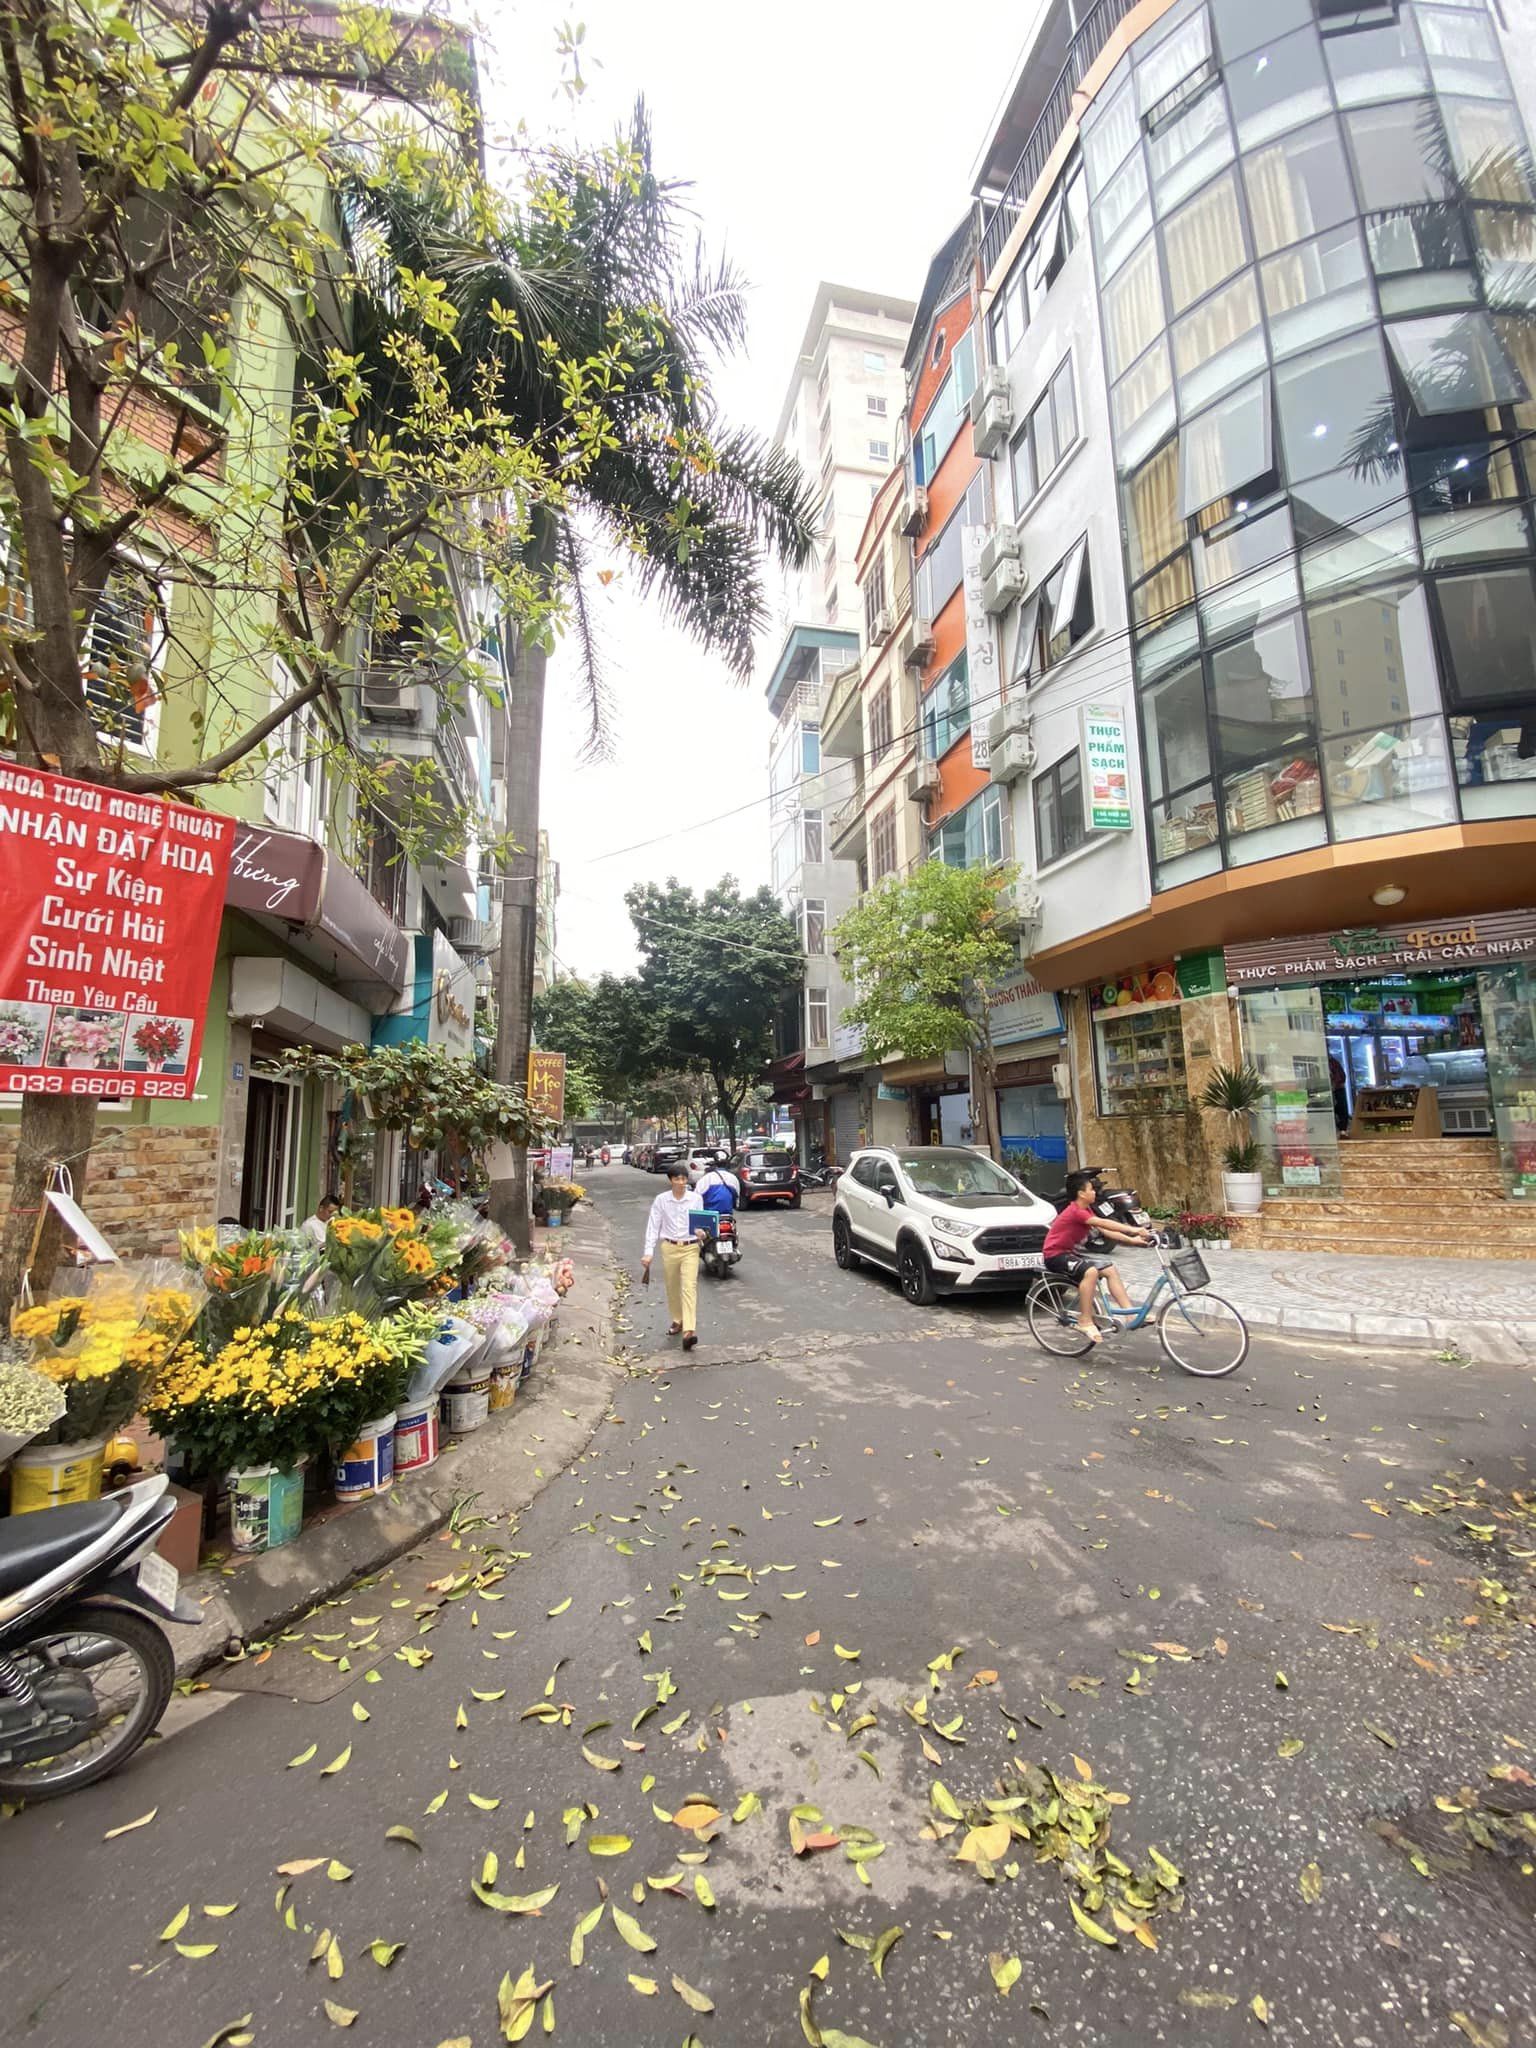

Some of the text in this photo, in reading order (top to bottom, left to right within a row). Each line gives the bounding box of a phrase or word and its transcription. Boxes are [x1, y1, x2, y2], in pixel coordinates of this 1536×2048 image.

[1089, 725, 1121, 738] THỰC
[1091, 758, 1125, 770] SẠCH
[0, 770, 225, 842] HOA TƯƠI NGHỆ THUẬT
[0, 804, 214, 876] NHẬN ĐẶT HOA
[55, 857, 163, 907] Sự Kiện
[41, 895, 166, 945] Cưới Hỏi
[1406, 926, 1478, 949] Food
[27, 935, 166, 986] Sinh Nhật
[1237, 965, 1278, 980] THỰC
[1334, 954, 1377, 970] SẠCH
[1392, 947, 1432, 964] TRÁI
[1487, 937, 1534, 954] NHẬP
[26, 978, 158, 1014] Theo Yêu Cầu
[533, 1058, 563, 1068] COFFEE
[9, 1073, 187, 1098] 033 6606 929
